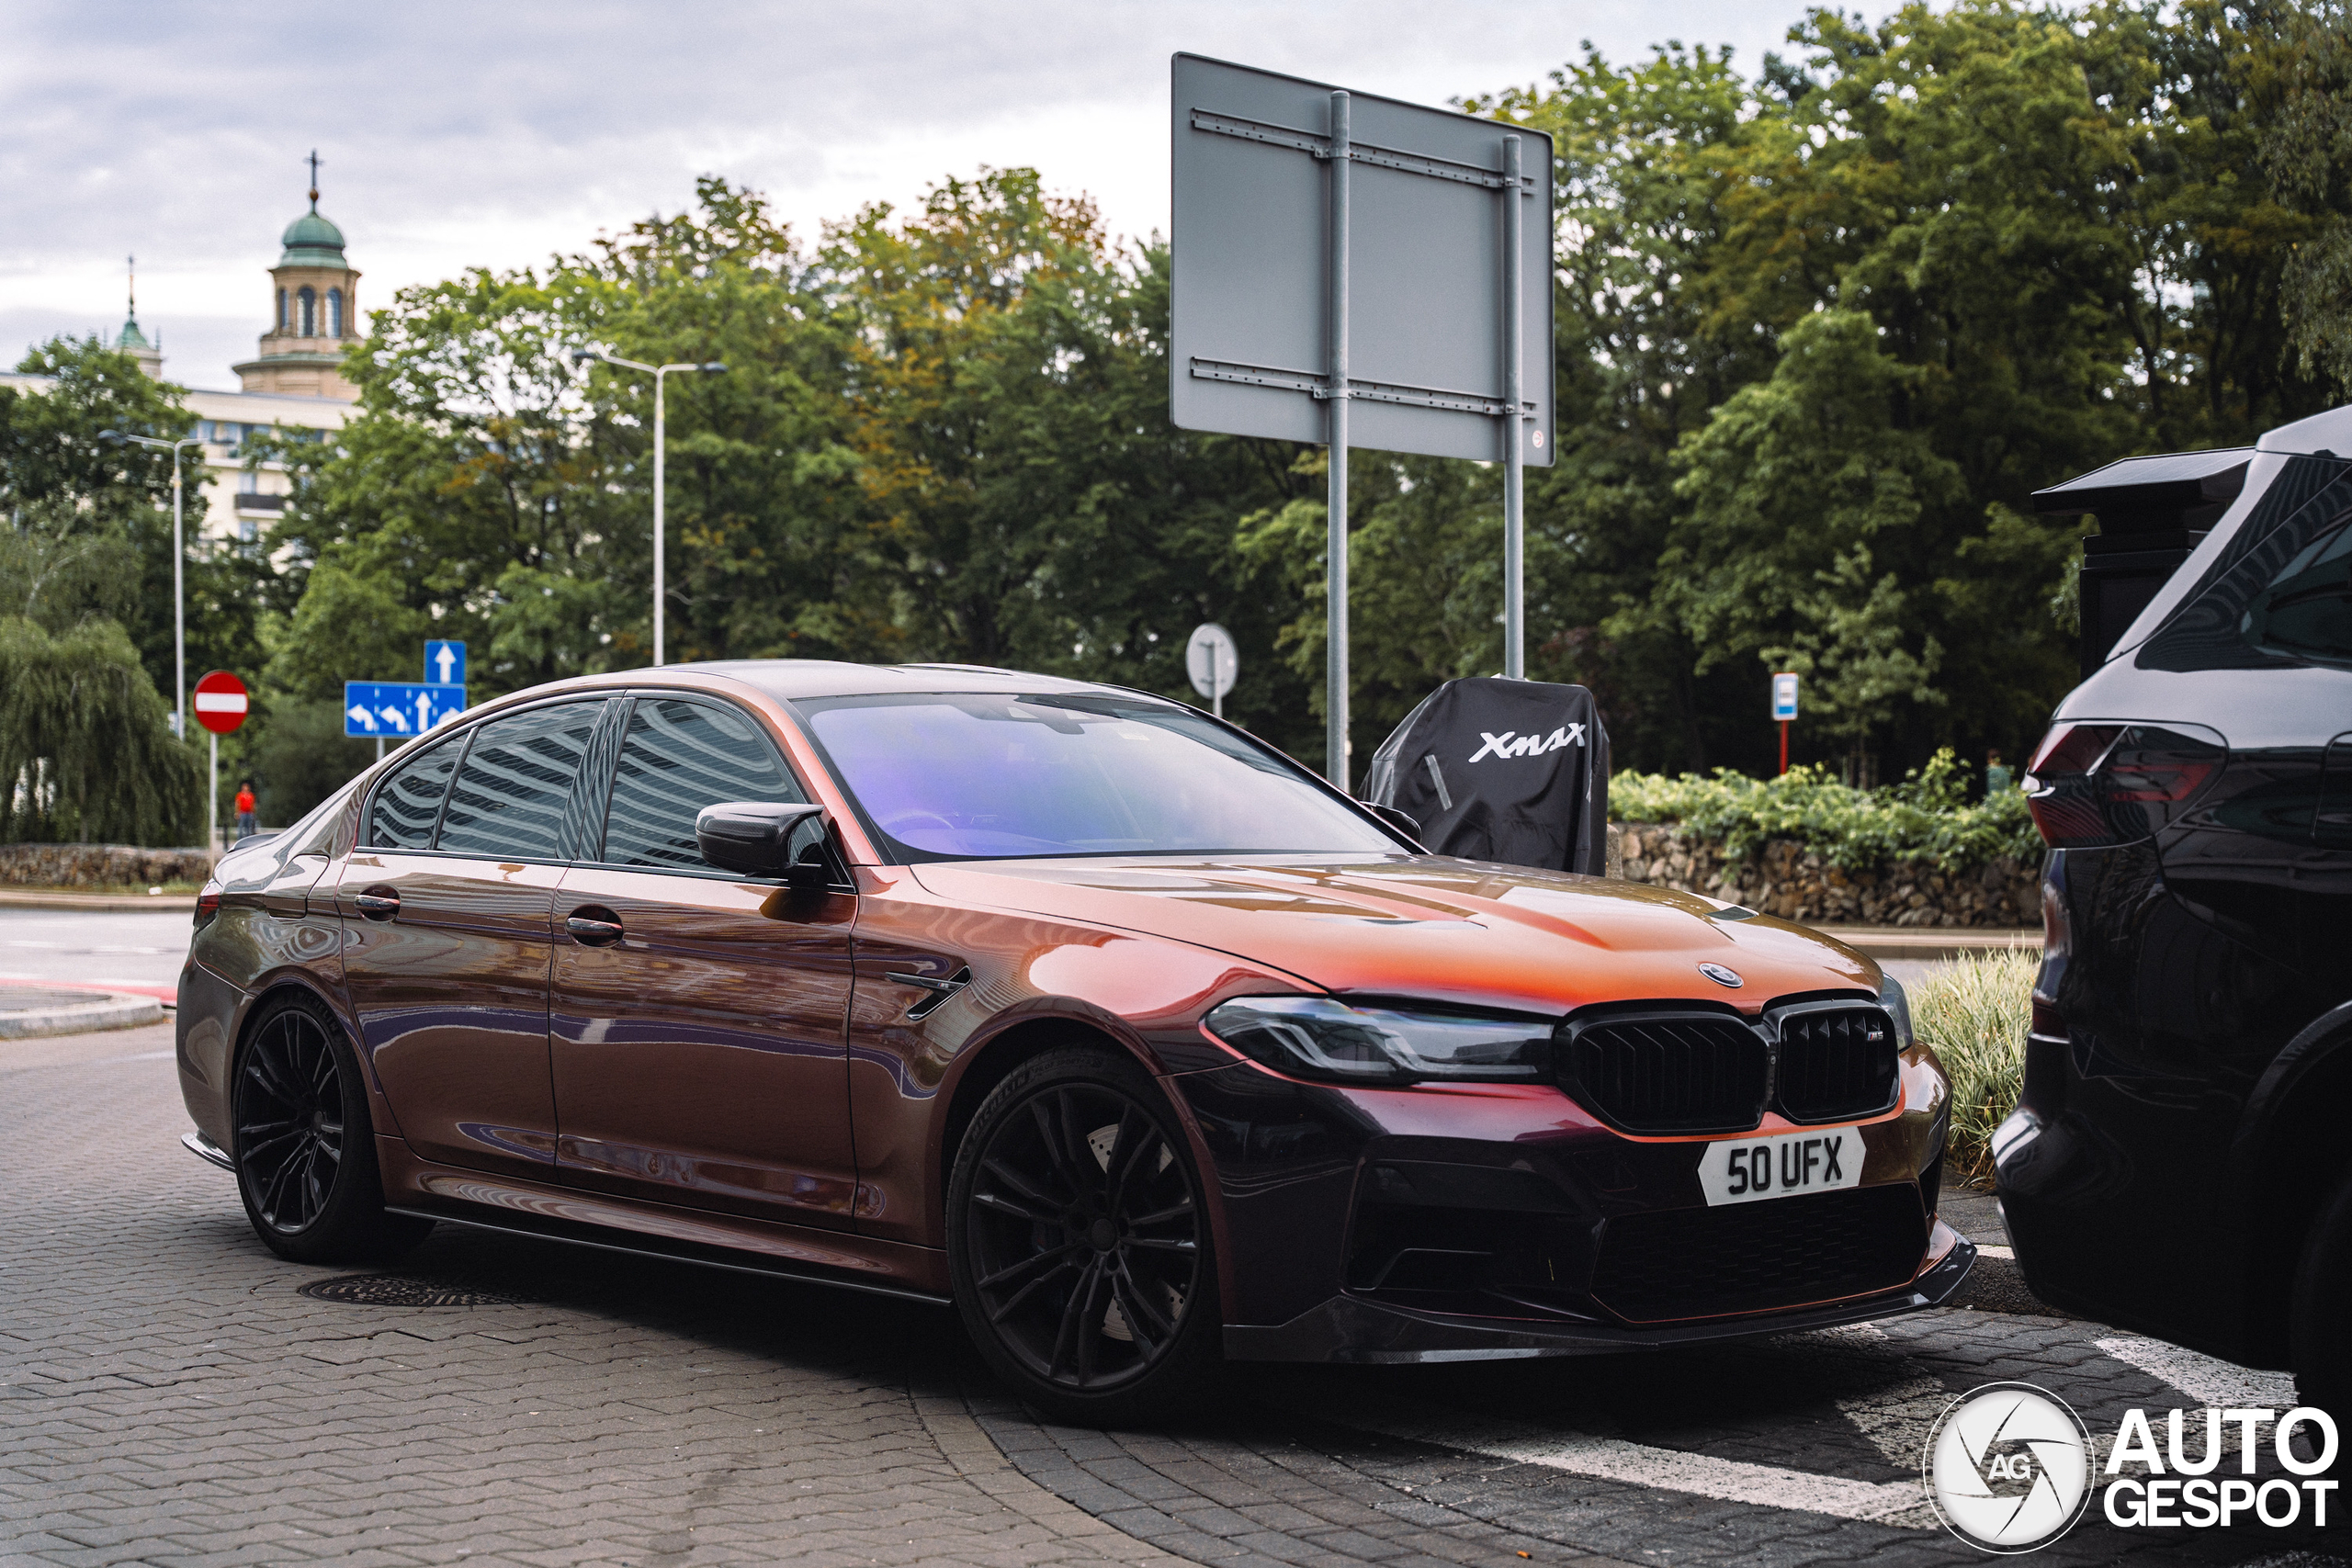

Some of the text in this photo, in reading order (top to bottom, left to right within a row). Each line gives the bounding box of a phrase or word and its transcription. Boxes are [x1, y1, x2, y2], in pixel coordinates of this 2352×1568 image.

[298, 992, 338, 1032] MICHELIN
[972, 1073, 1026, 1140] MICHELIN
[1728, 1135, 1843, 1195] 50 UFX
